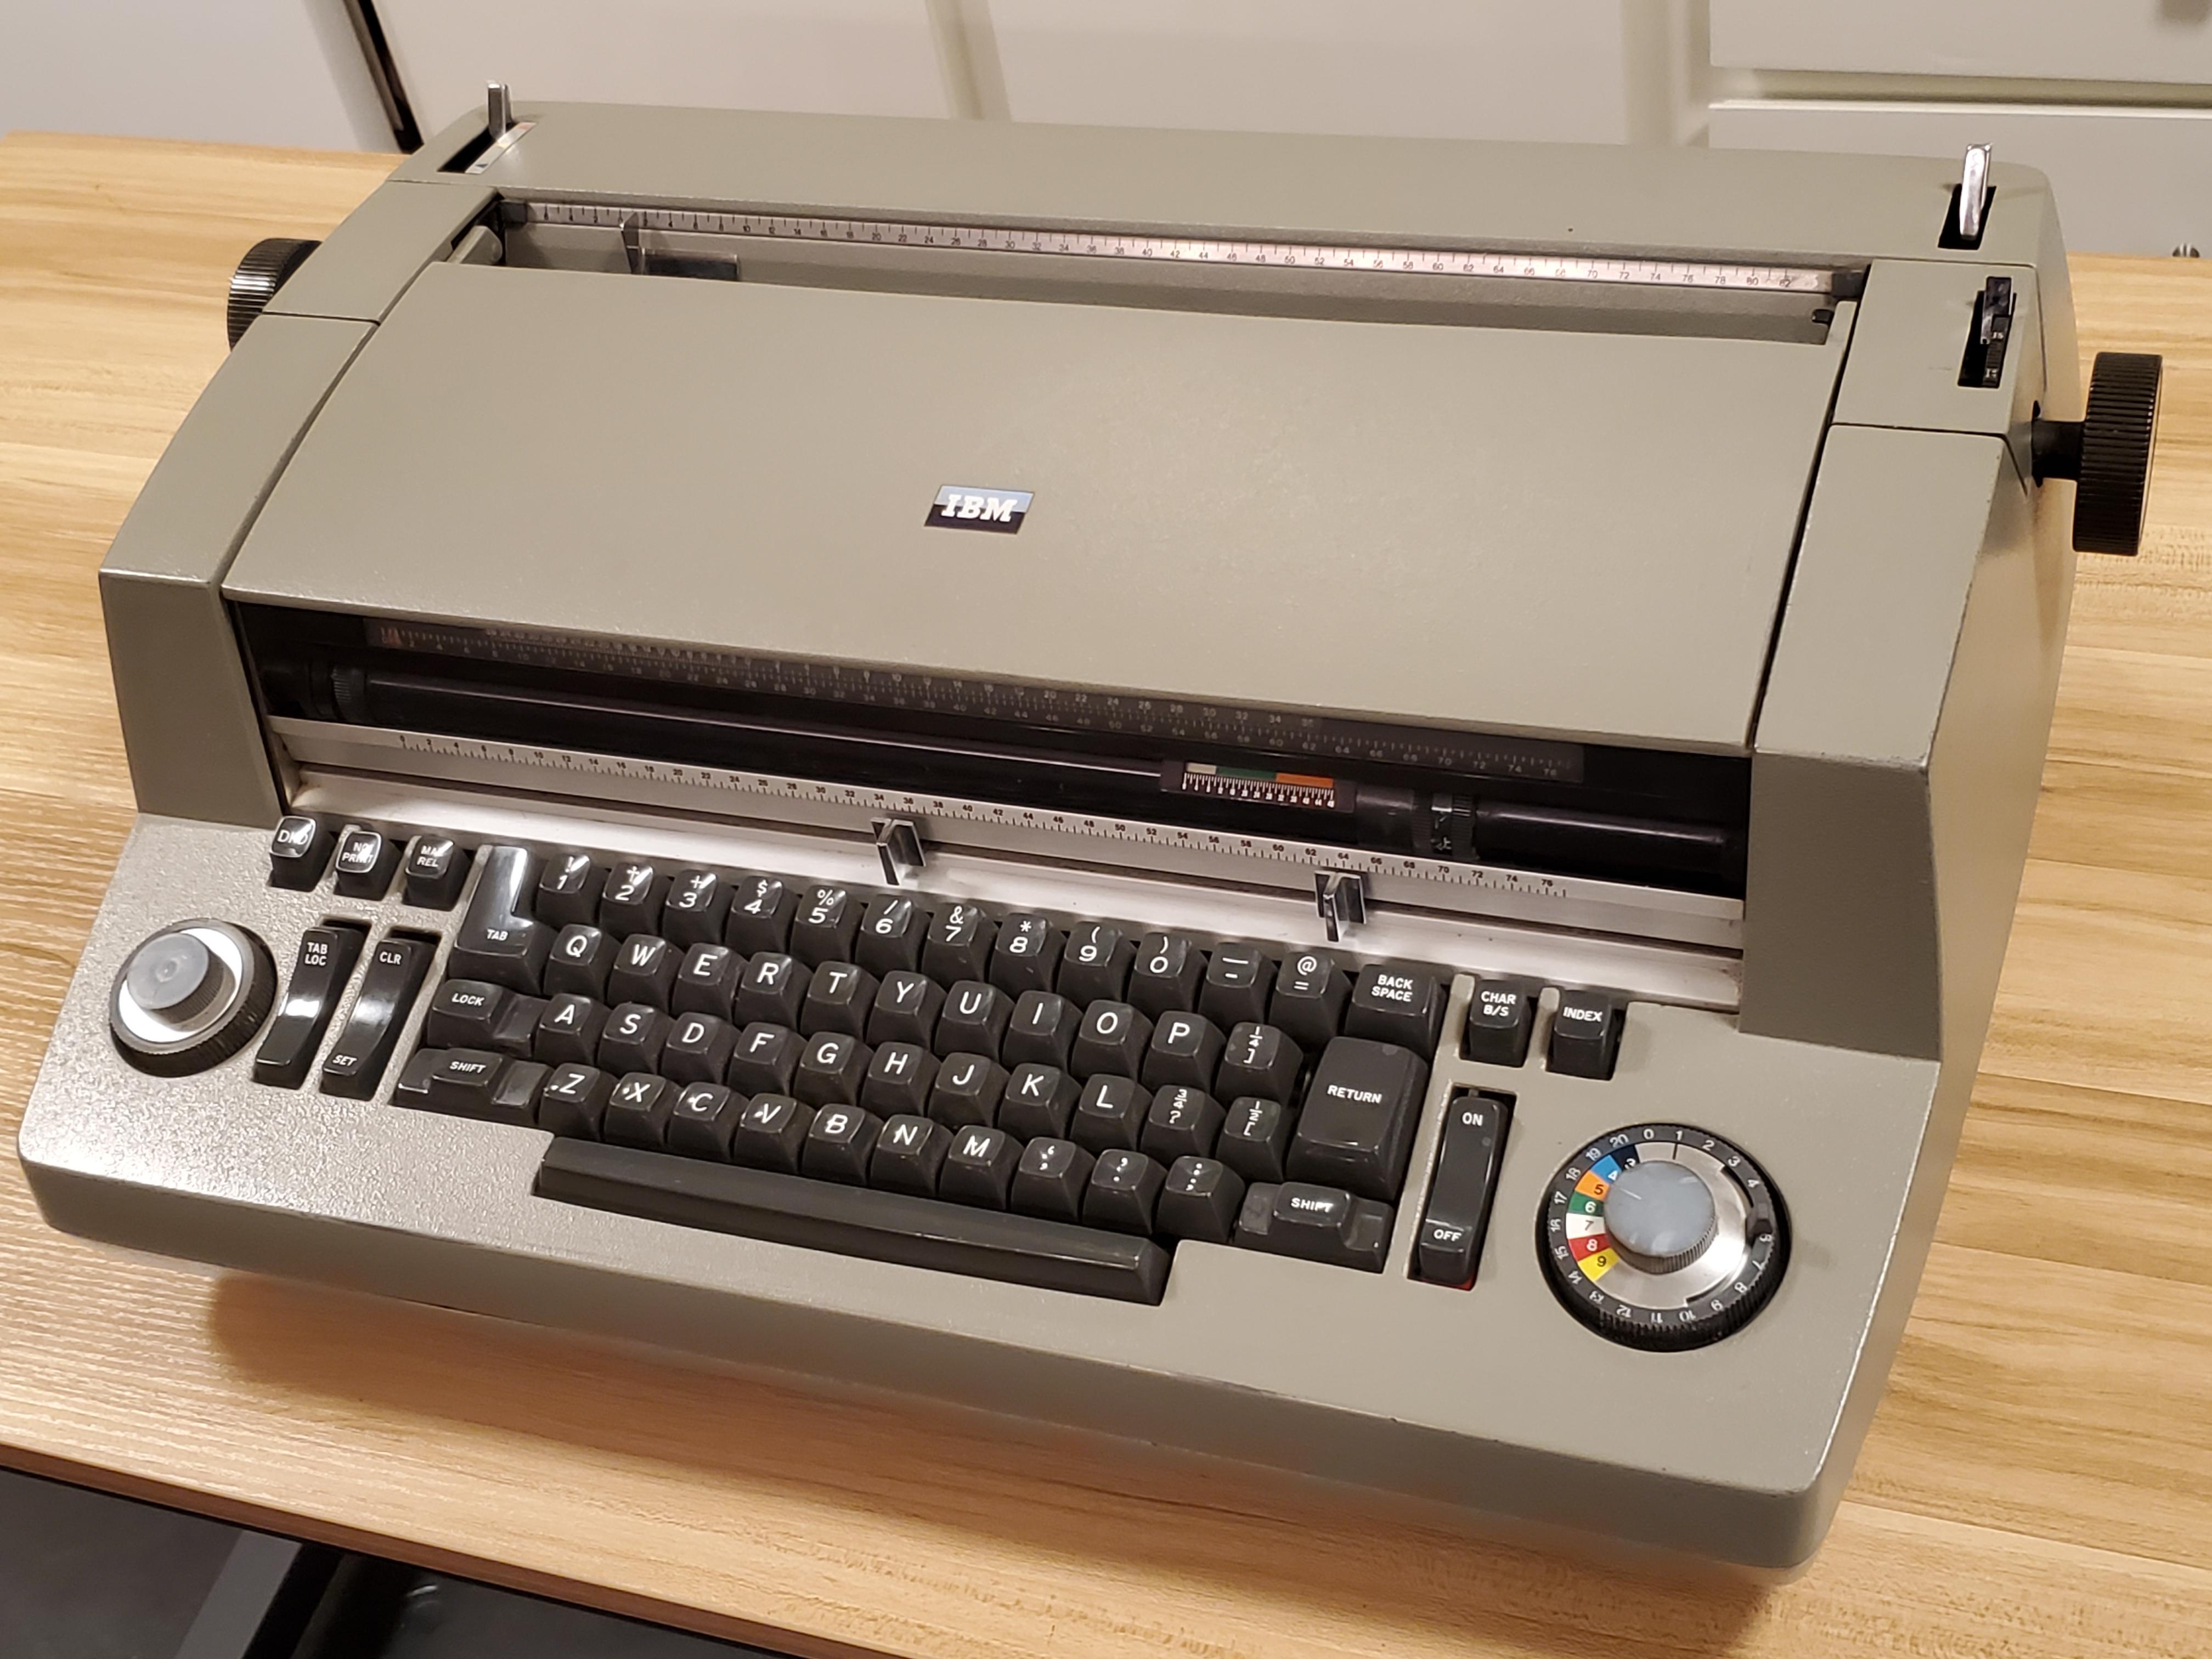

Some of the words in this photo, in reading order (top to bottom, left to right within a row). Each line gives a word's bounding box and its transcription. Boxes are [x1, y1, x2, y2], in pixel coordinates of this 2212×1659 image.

[941, 494, 1018, 522] IBM
[816, 786, 826, 794] 30
[933, 800, 943, 809] 38
[962, 804, 973, 812] 40
[992, 808, 1003, 816] 42
[1023, 812, 1034, 820] 44
[1084, 820, 1094, 828] 48
[1115, 823, 1126, 832] 50
[1146, 827, 1157, 836] 52
[1177, 832, 1188, 840] 54
[1240, 839, 1251, 848] 58
[1272, 844, 1284, 852] 60
[1305, 848, 1317, 856] 62
[1370, 856, 1383, 865] 66
[1403, 860, 1415, 869] 68
[1438, 865, 1450, 874] 70
[1471, 870, 1483, 878] 72
[1505, 874, 1518, 883] 74
[1541, 878, 1554, 887] 76
[420, 845, 443, 856] MA
[417, 856, 438, 867] REL
[557, 875, 568, 889] 1
[757, 879, 768, 897] $
[615, 885, 634, 901] 2
[679, 893, 697, 907] 3
[817, 889, 834, 906] %
[744, 899, 763, 913] 4
[808, 907, 828, 923] 5
[949, 906, 964, 924] &
[875, 918, 894, 933] 6
[945, 925, 962, 941] 7
[486, 929, 508, 941] TAB
[1091, 926, 1101, 944] (
[307, 941, 328, 955] TAB
[566, 935, 587, 957] Q
[1009, 936, 1028, 953] 8
[1160, 936, 1169, 953] )
[304, 954, 327, 966] LOC
[380, 952, 402, 965] CLR
[631, 944, 656, 966] W
[1079, 945, 1097, 961] 9
[693, 953, 718, 975] E
[1297, 956, 1317, 975] @
[757, 962, 778, 985] R
[829, 972, 847, 994] T
[1378, 974, 1413, 990] BACK
[452, 993, 484, 1006] LOCK
[896, 981, 914, 1003] Y
[1372, 986, 1413, 1002] SPACE
[1481, 990, 1516, 1005] CHAR
[960, 991, 981, 1014] U
[554, 1004, 575, 1024] A
[1032, 1002, 1043, 1024] I
[1483, 1004, 1509, 1017] B/S
[1563, 1007, 1603, 1023] INDEX
[619, 1014, 641, 1034] S
[1097, 1012, 1118, 1034] O
[682, 1023, 704, 1043] D
[1167, 1022, 1190, 1043] P
[749, 1032, 775, 1053] F
[332, 1054, 357, 1066] SET
[817, 1042, 839, 1064] G
[449, 1061, 486, 1074] SHIFT
[884, 1052, 909, 1074] H
[952, 1064, 975, 1085] J
[1021, 1074, 1044, 1096] K
[1096, 1085, 1114, 1109] L
[1327, 1085, 1382, 1104] RETURN
[825, 1114, 848, 1134] B
[1169, 1110, 1181, 1124] ?
[1462, 1111, 1483, 1126] ON
[893, 1124, 918, 1146] N
[1610, 1134, 1629, 1148] 20
[1643, 1128, 1654, 1139] 0
[1675, 1130, 1683, 1141] 1
[963, 1135, 990, 1158] M
[1702, 1140, 1714, 1151] 2
[1585, 1148, 1601, 1161] 19
[1728, 1156, 1741, 1167] 3
[1566, 1167, 1582, 1181] 18
[1608, 1170, 1618, 1181] 4
[1594, 1184, 1604, 1195] 5
[1747, 1180, 1759, 1188] 4
[1291, 1197, 1333, 1212] SHIFT
[1554, 1191, 1567, 1205] 17
[1585, 1201, 1596, 1213] 6
[1550, 1218, 1561, 1232] 16
[1584, 1220, 1594, 1231] 7
[1433, 1229, 1462, 1242] OFF
[1555, 1245, 1569, 1260] 15
[1586, 1239, 1598, 1251] 8
[1596, 1256, 1607, 1267] 9
[1734, 1282, 1748, 1293] 8
[1589, 1290, 1604, 1304] 13
[1616, 1305, 1632, 1318] 12
[1651, 1312, 1663, 1324] 11
[1679, 1310, 1696, 1322] 10
